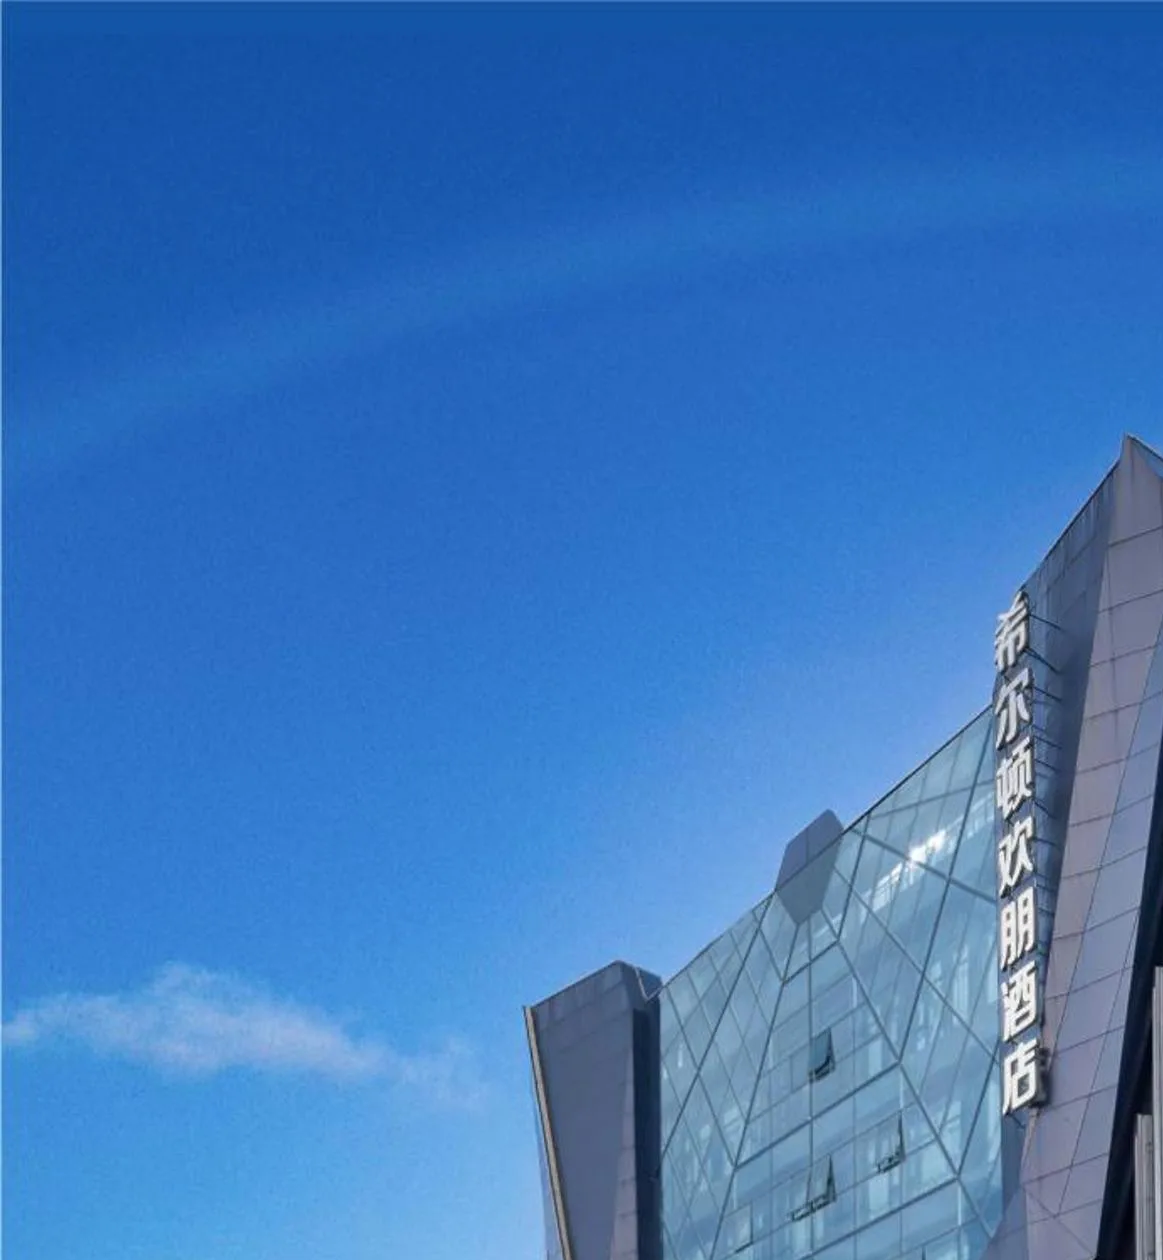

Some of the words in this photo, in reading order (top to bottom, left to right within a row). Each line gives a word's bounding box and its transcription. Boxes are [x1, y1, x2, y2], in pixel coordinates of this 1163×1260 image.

[994, 590, 1039, 1115] 希尔顿欢朋酒店
